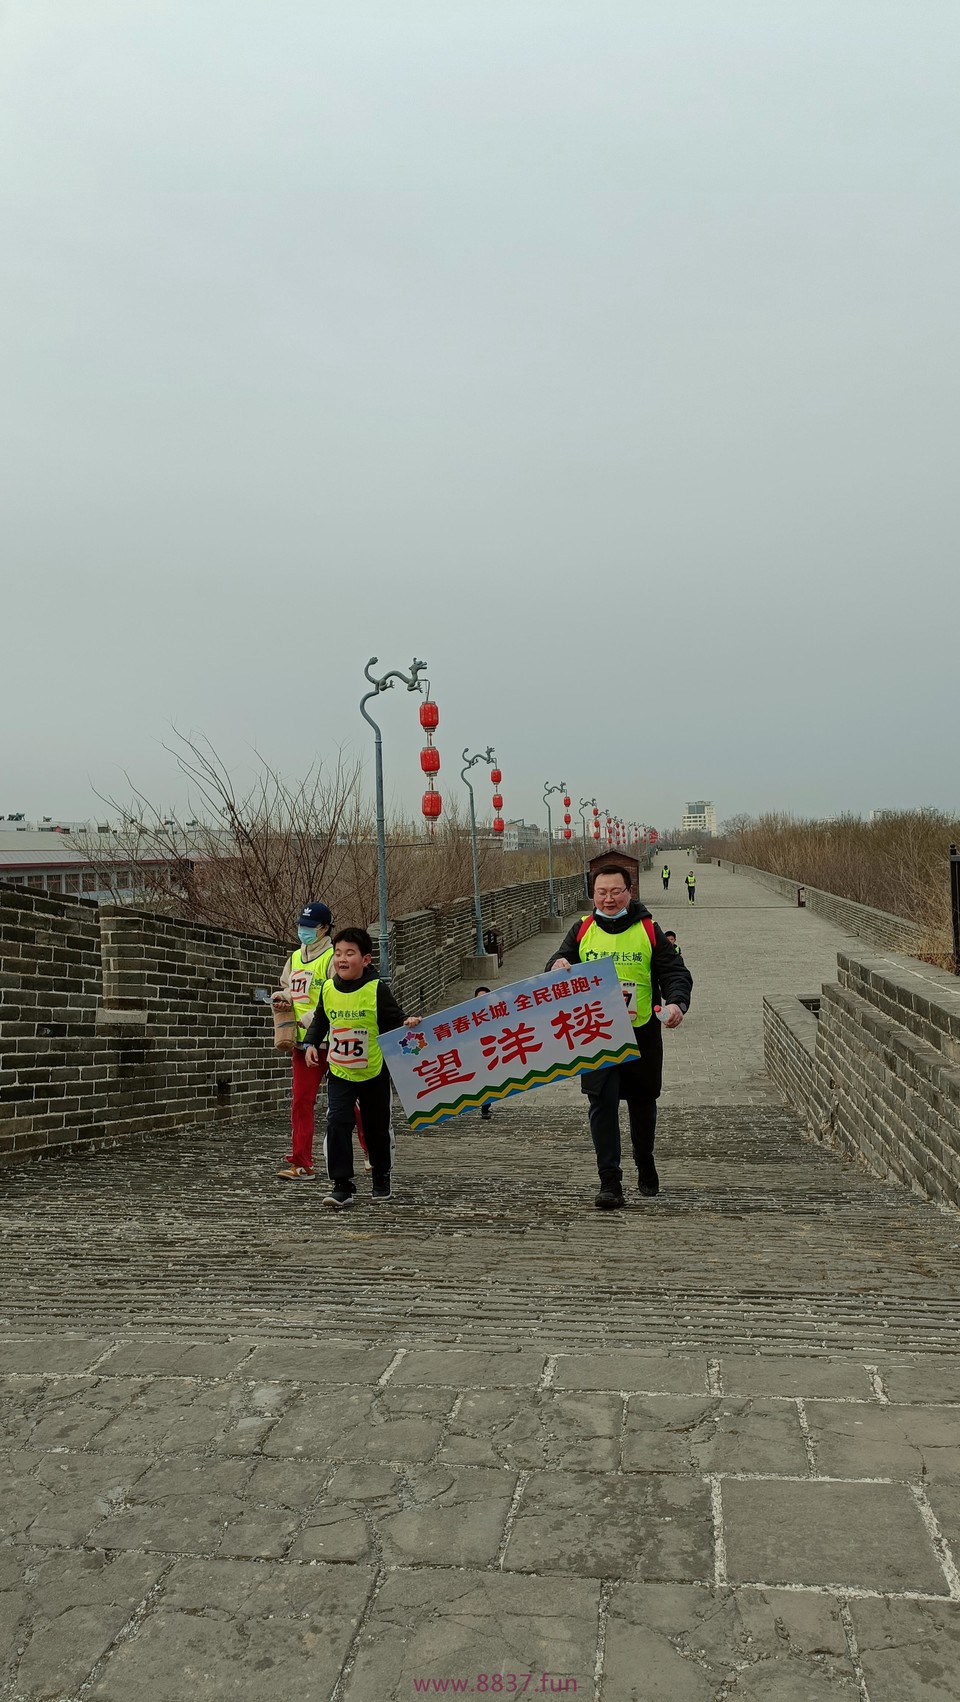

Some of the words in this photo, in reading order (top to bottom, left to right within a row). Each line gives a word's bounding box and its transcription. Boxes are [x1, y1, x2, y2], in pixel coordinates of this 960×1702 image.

[291, 978, 307, 993] 171
[338, 1010, 367, 1018] 青春长城
[432, 1001, 510, 1042] 青春长城
[513, 975, 603, 1012] 全民健跑+
[333, 1037, 363, 1057] 215
[412, 1000, 614, 1100] 望洋楼
